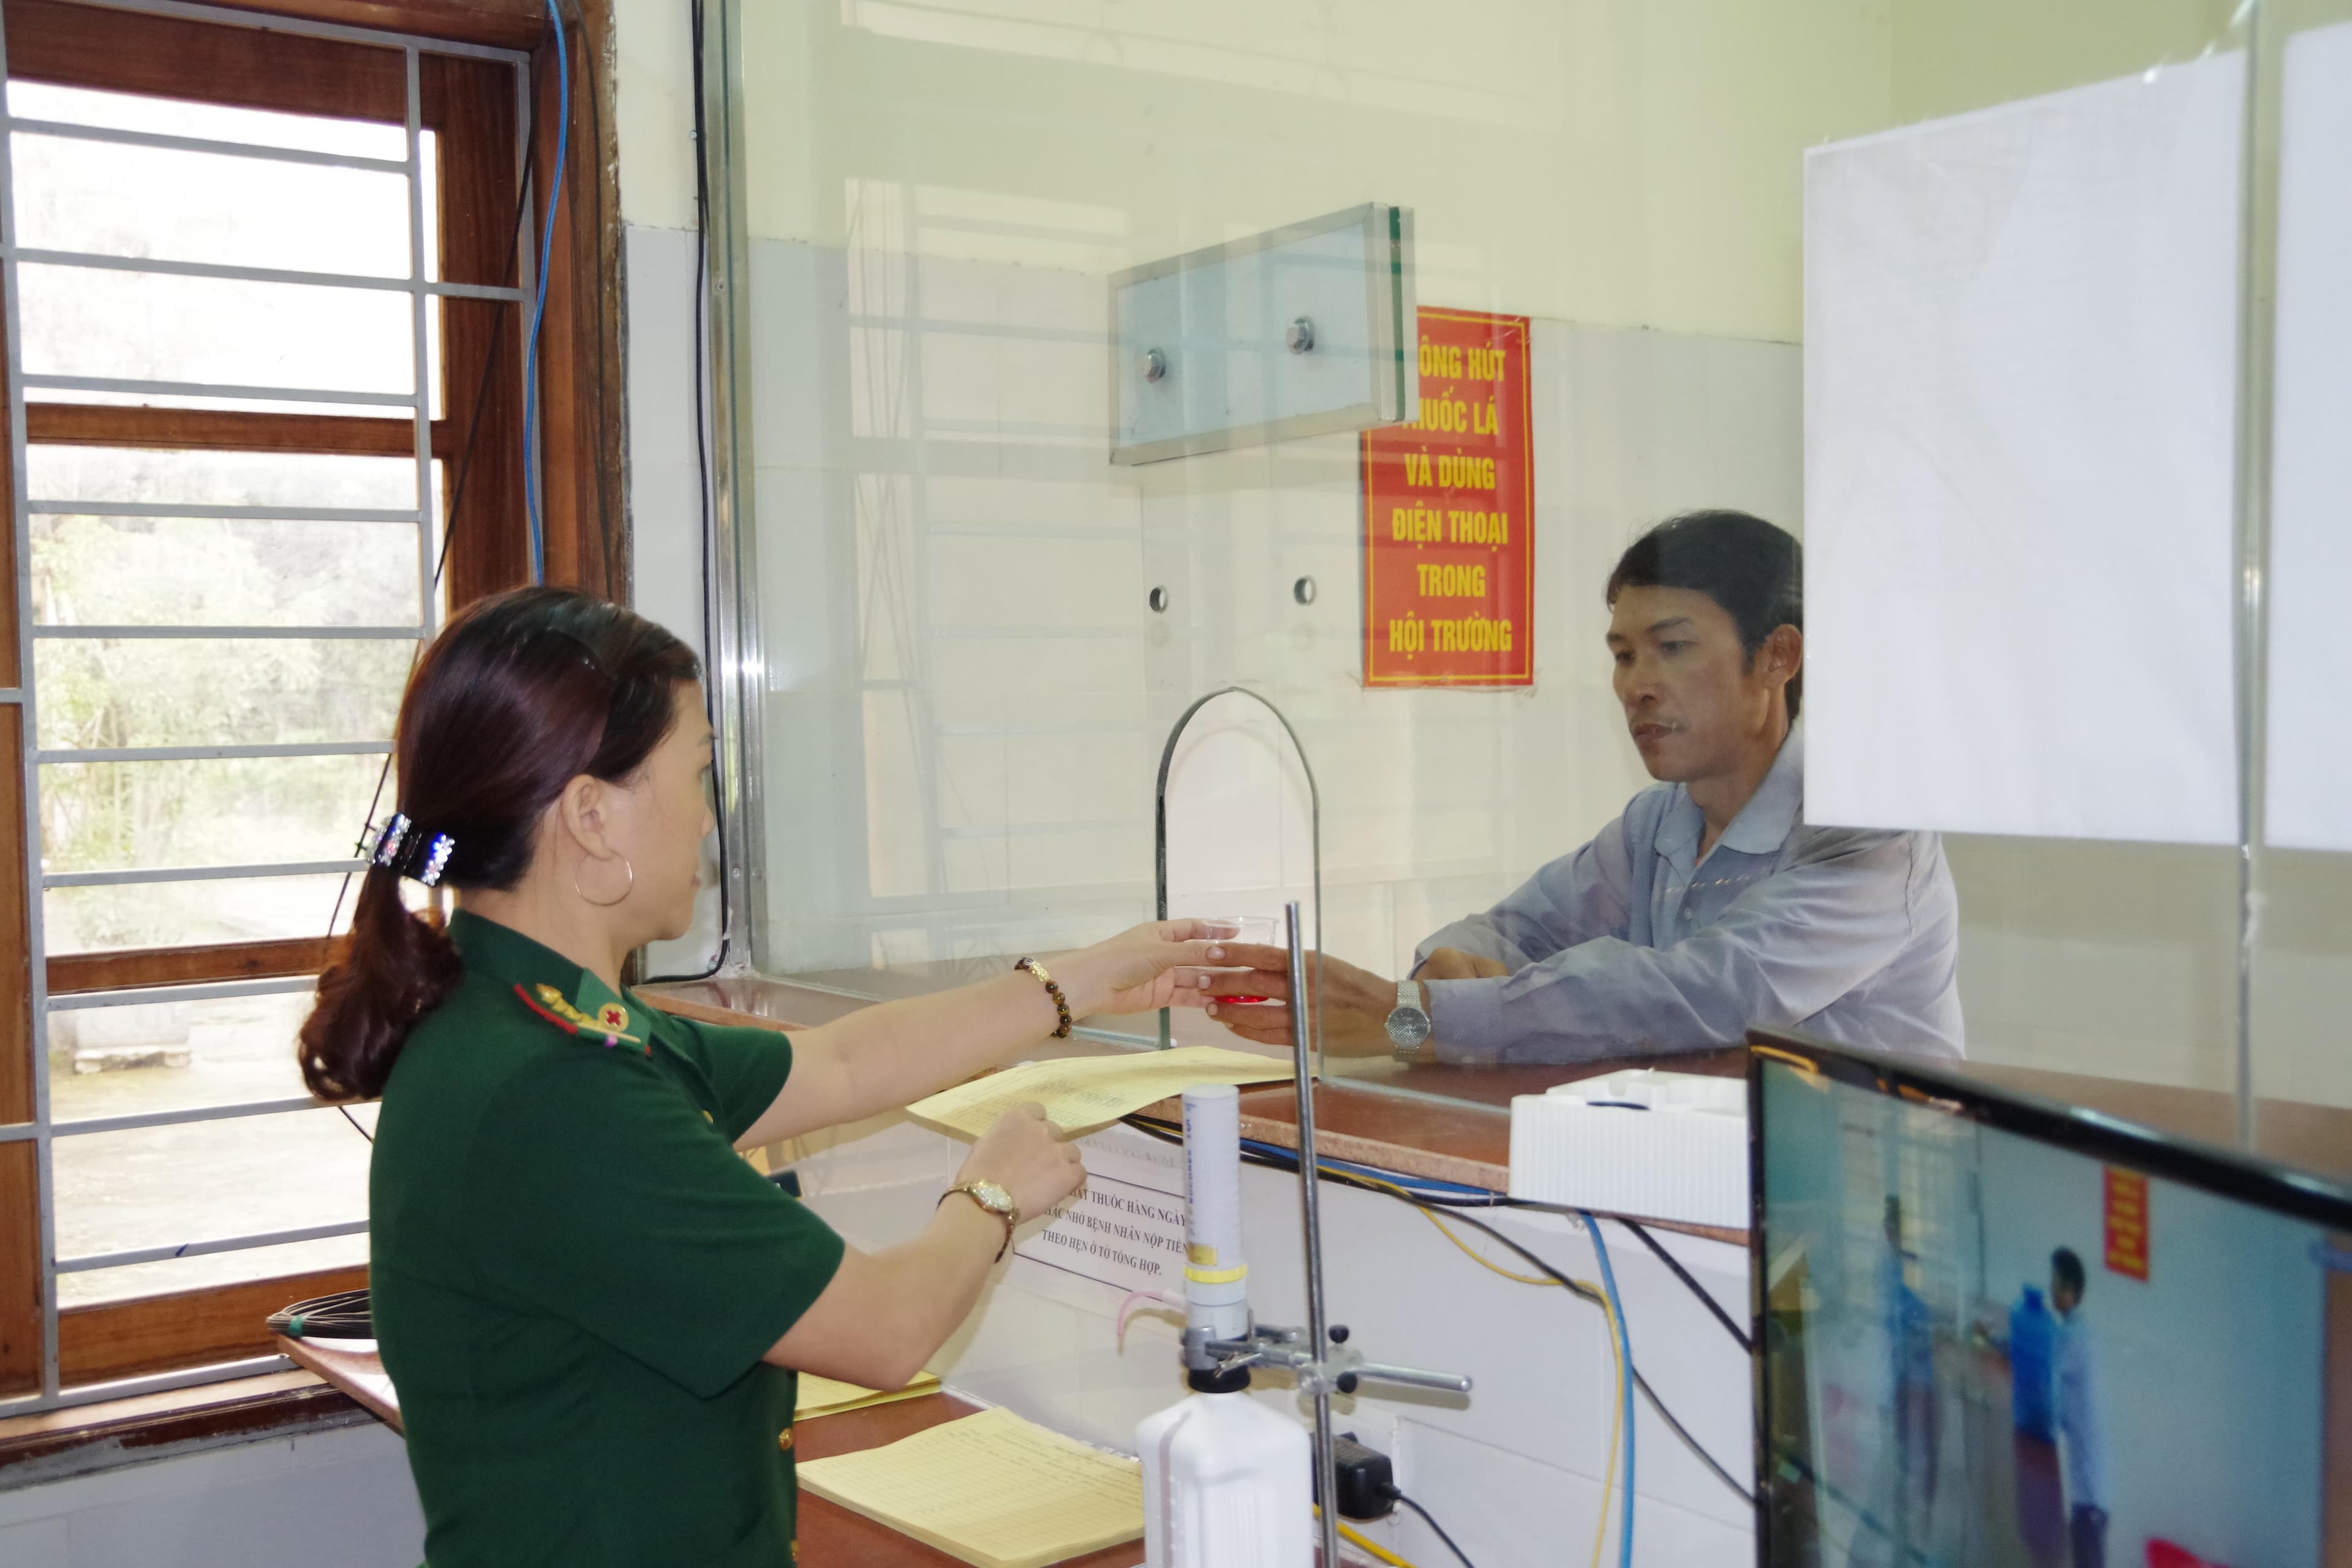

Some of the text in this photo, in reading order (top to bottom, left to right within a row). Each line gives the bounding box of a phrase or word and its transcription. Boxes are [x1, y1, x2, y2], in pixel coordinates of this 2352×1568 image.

[1419, 334, 1506, 382] ÔNG HÚT
[1473, 395, 1499, 435] LÁ
[1404, 445, 1495, 490] VÀ DÙNG
[1392, 500, 1508, 552] ĐIỆN THOẠI
[1417, 564, 1485, 597] TRONG
[1390, 611, 1512, 660] HỘI TRƯỜNG
[1091, 1190, 1125, 1210] THUỐC
[1127, 1199, 1155, 1219] HÀNG
[1042, 1229, 1067, 1246] THEO
[1069, 1237, 1088, 1253] HẸN
[1139, 1257, 1161, 1276] HỢP.
[1087, 1216, 1111, 1234] BỆNH
[1113, 1224, 1139, 1241] NHÂN
[1142, 1232, 1164, 1249] NỘP
